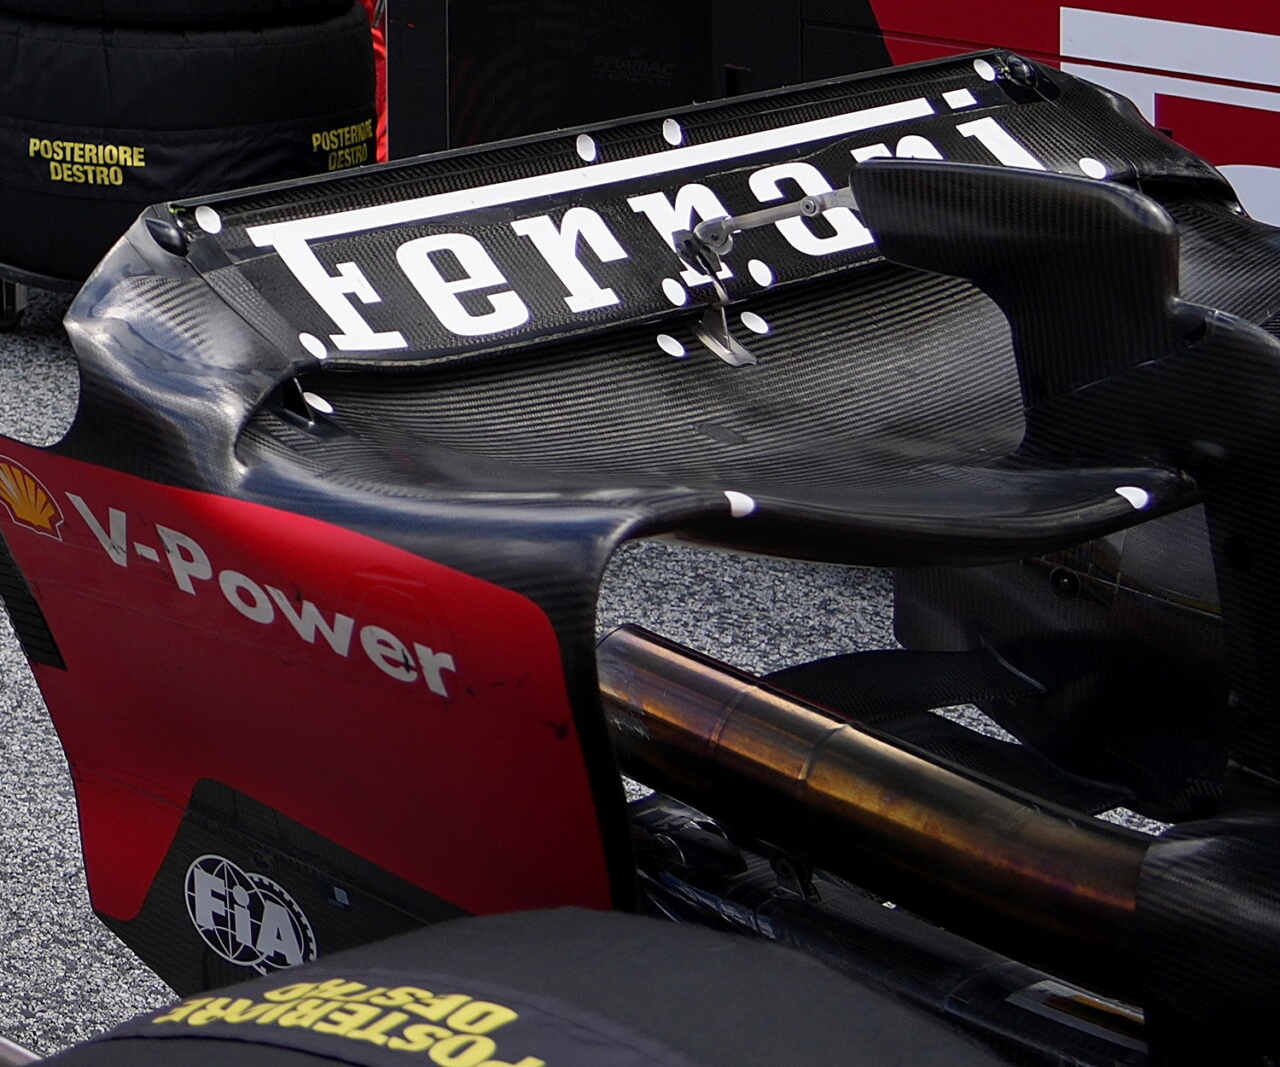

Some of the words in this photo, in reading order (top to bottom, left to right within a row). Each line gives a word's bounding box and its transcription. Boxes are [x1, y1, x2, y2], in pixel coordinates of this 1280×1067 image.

[29, 137, 146, 167] POSTERIORE
[328, 142, 368, 171] DESTRO
[50, 161, 123, 186] DESTRO
[65, 491, 456, 698] V-Power
